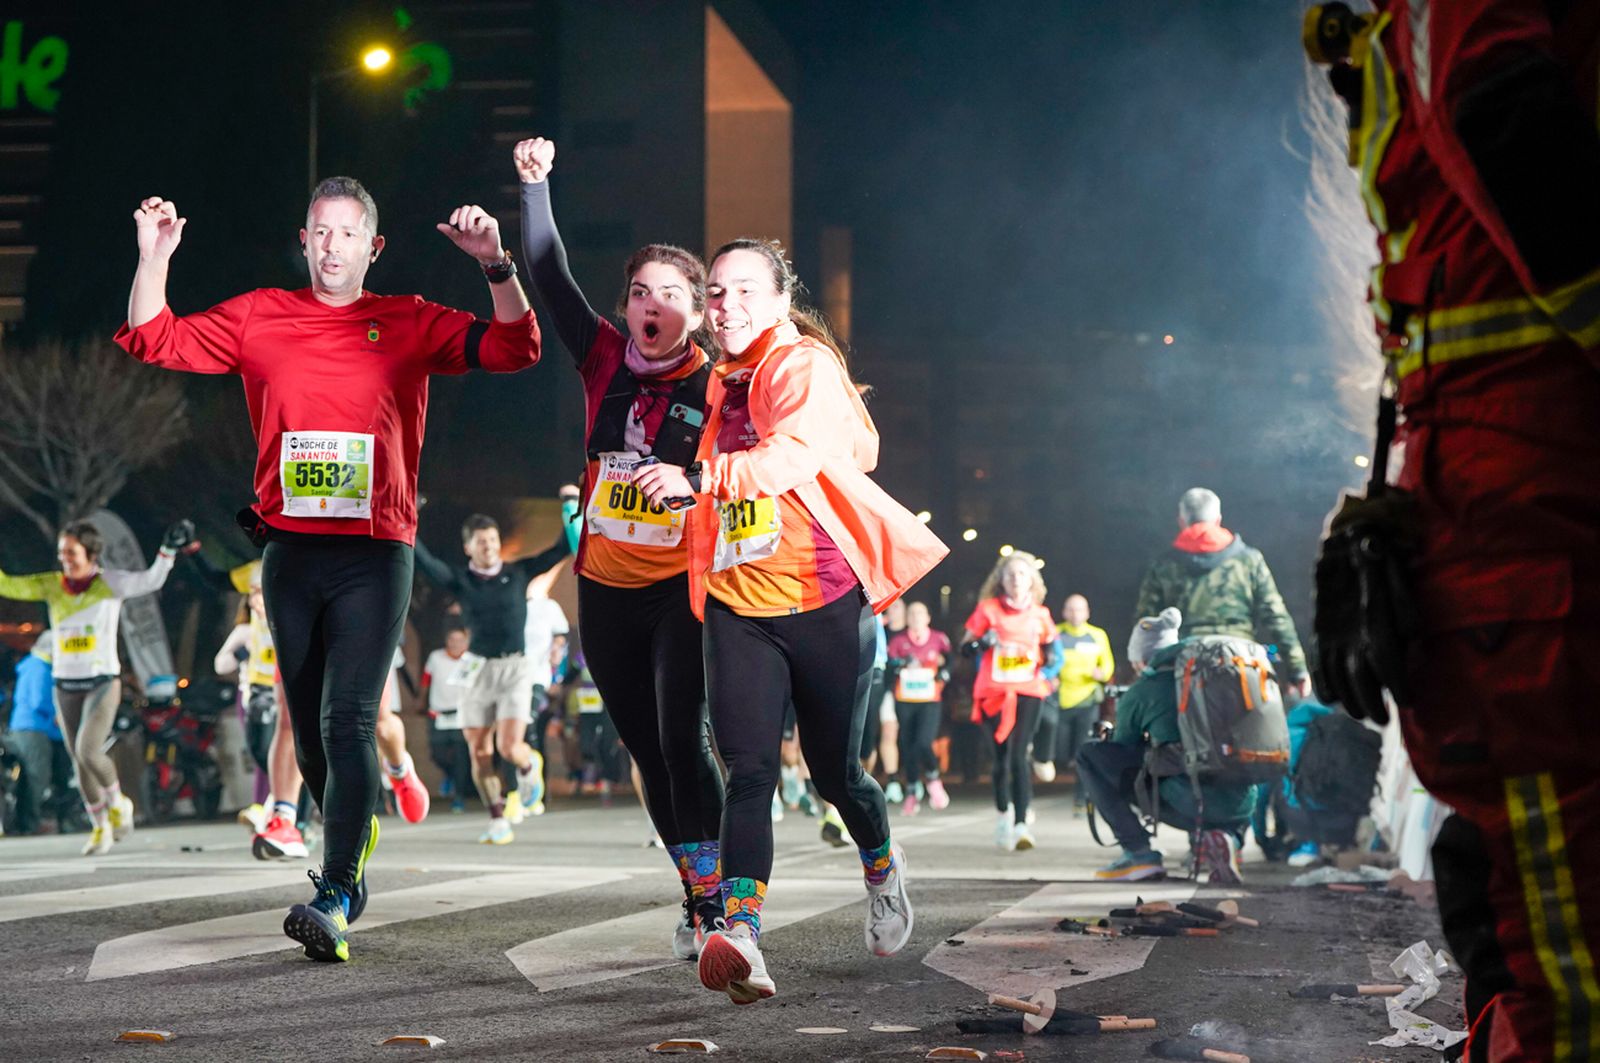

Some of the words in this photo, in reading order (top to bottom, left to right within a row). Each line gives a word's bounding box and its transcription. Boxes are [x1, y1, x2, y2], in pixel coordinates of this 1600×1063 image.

[300, 441, 325, 449] NOCHE
[327, 441, 338, 449] DE
[290, 451, 306, 460] SAN
[296, 462, 356, 488] 5532
[606, 471, 622, 481] SAN
[623, 512, 643, 521] Andrea
